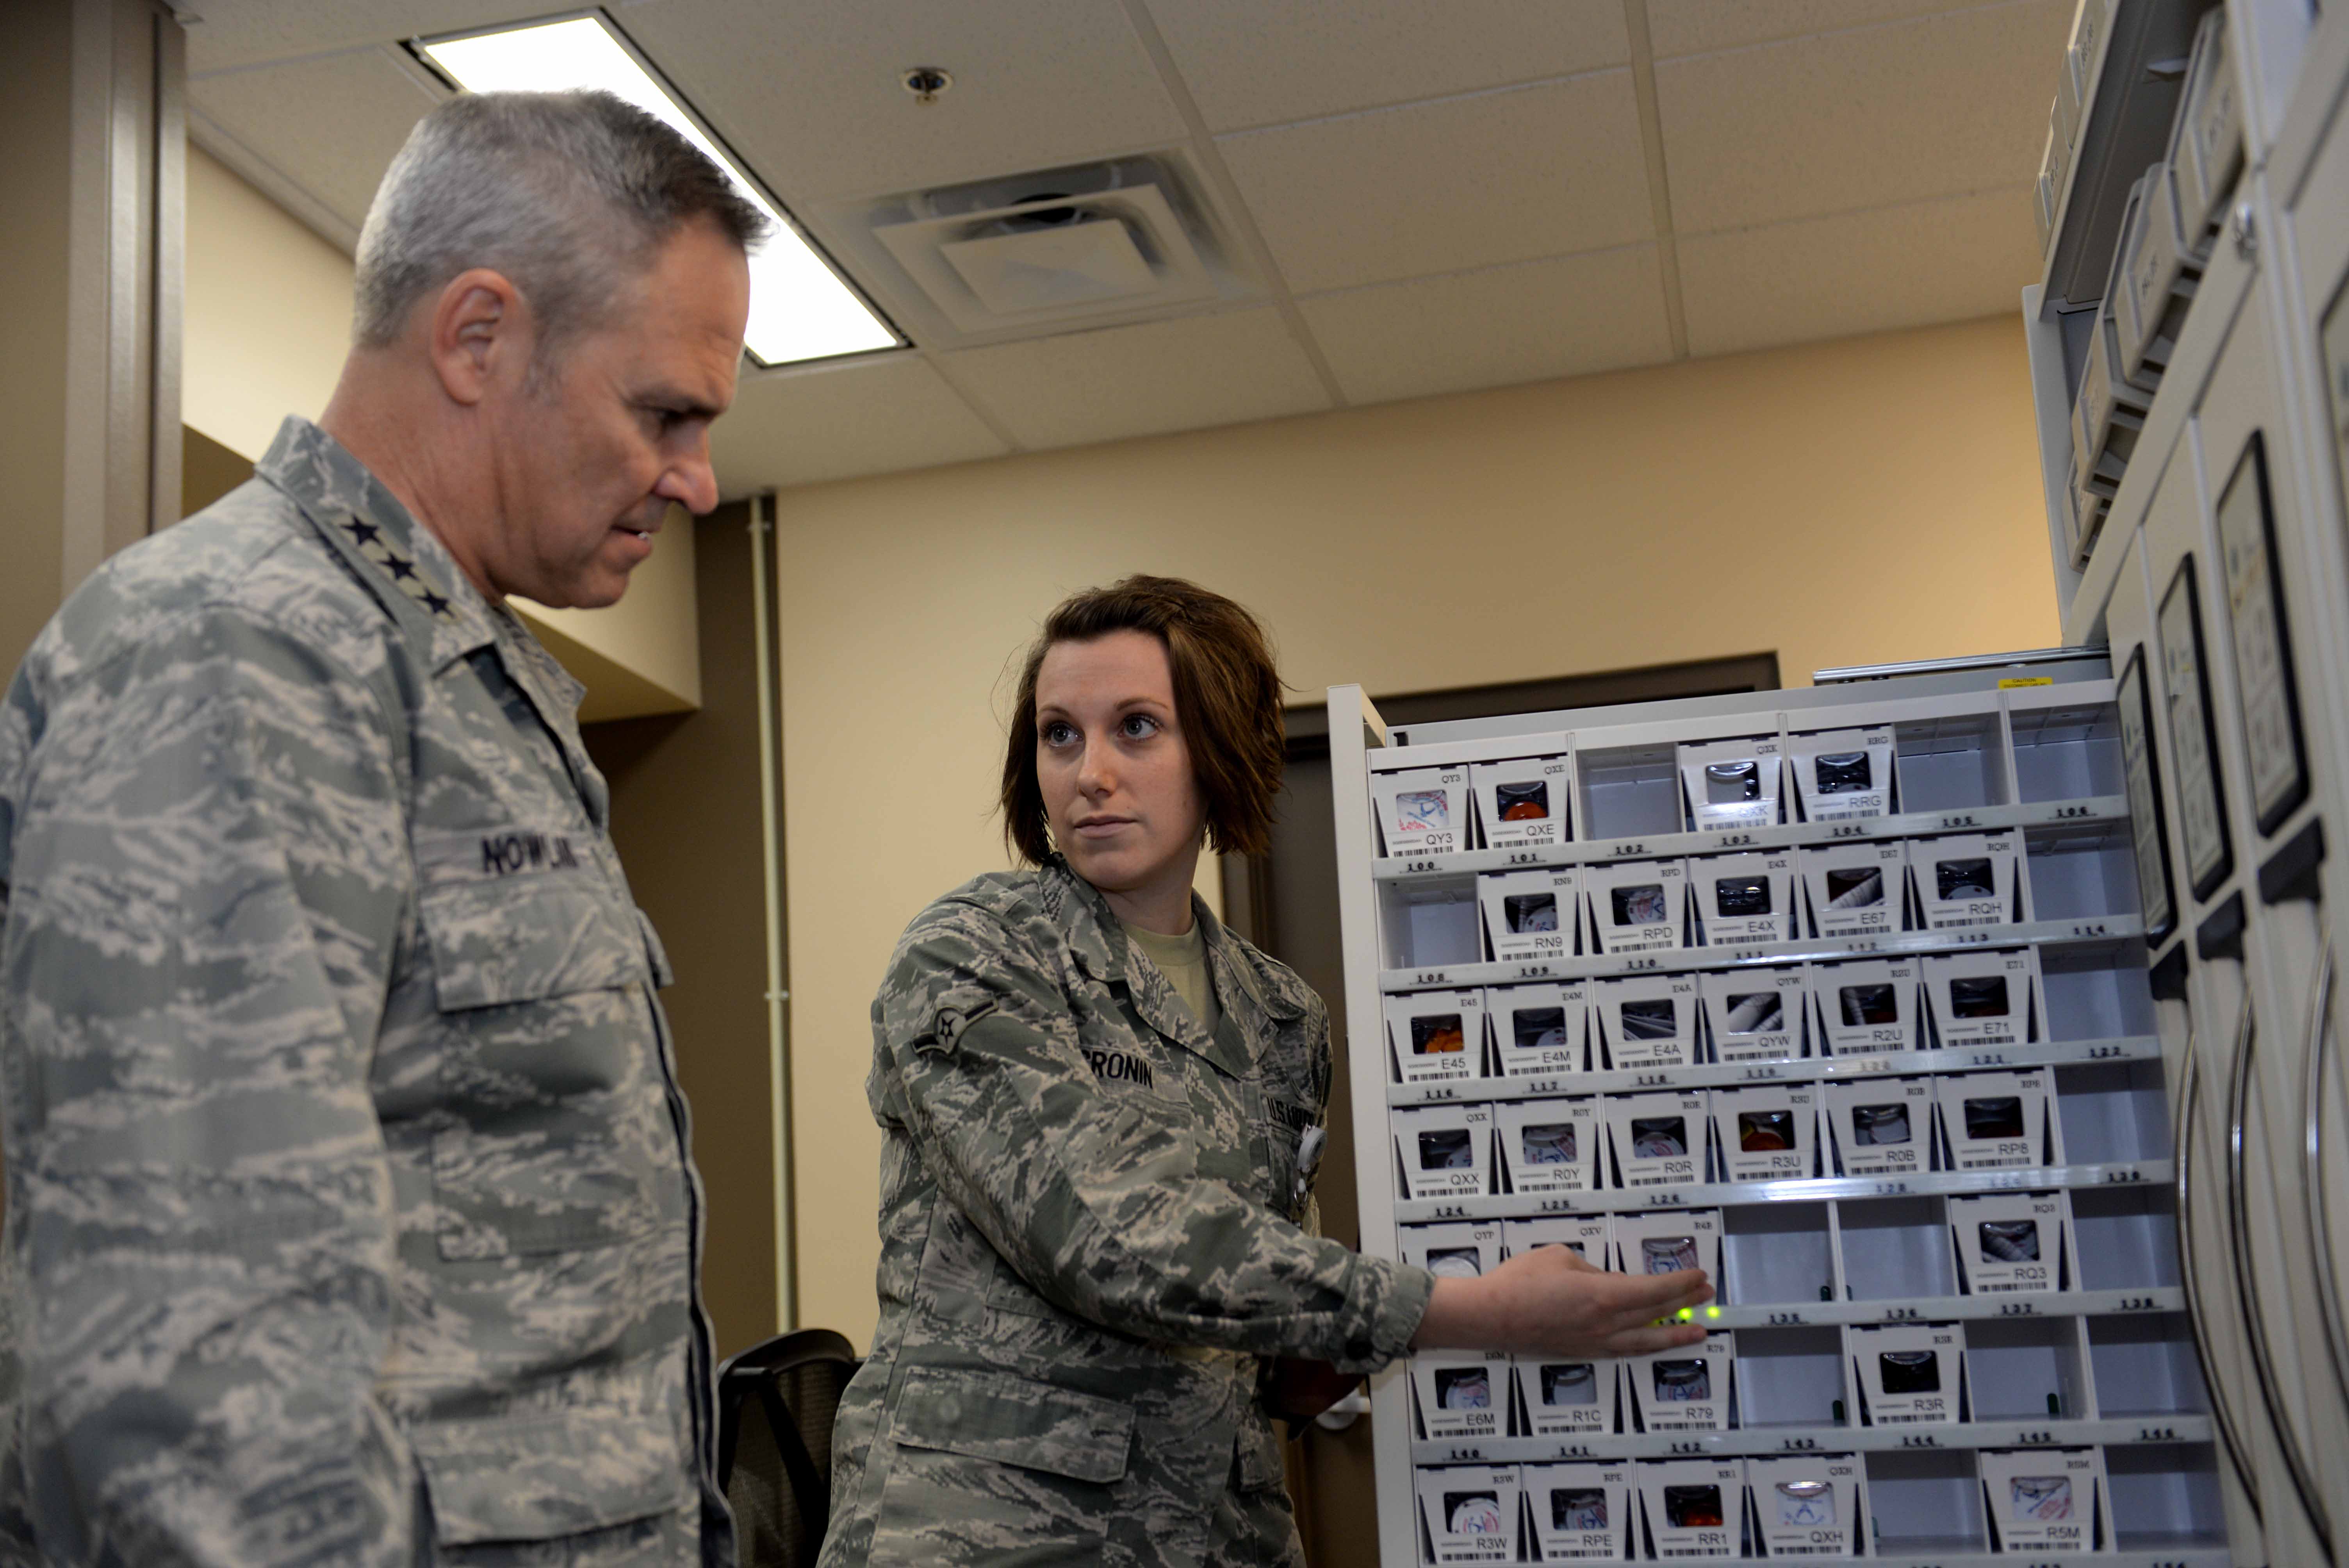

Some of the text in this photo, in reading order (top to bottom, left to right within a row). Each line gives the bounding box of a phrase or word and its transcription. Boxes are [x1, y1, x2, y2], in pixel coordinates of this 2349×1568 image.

[1544, 764, 1565, 775] QXE
[1442, 774, 1461, 784] QY3
[1850, 795, 1882, 807] RRG
[1527, 824, 1554, 836] QXE
[1426, 832, 1453, 845] QY3
[1768, 860, 1787, 869] E4X
[1661, 868, 1681, 877] RPD
[1553, 877, 1572, 886] RN9
[1969, 902, 2002, 914] RQH
[1861, 912, 1886, 925] E67
[1643, 927, 1673, 939] RPD
[1748, 921, 1775, 933] E4X
[1535, 937, 1563, 948] RN9
[1891, 969, 1910, 978] R2U
[1777, 977, 1800, 987] QYW
[1672, 984, 1692, 993] E4A
[1461, 998, 1477, 1007] E45
[1562, 992, 1583, 1001] E4M
[1984, 1022, 2009, 1034] E71
[1759, 1036, 1790, 1047] QYW
[1873, 1030, 1902, 1041] R2U
[1654, 1044, 1681, 1057] E4A
[1442, 1057, 1466, 1069] E45
[1543, 1051, 1570, 1063] E4M
[1467, 1113, 1487, 1123] QXX
[1999, 1143, 2028, 1155] RP8
[1772, 1156, 1801, 1168] R3U
[1451, 1174, 1479, 1185] QXX
[1474, 1231, 1494, 1241] QYP
[1581, 1227, 1601, 1237] QXV
[2014, 1267, 2047, 1279] RQ3
[1914, 1398, 1944, 1411] R3R
[1467, 1413, 1495, 1425] E6M
[1573, 1410, 1601, 1422] R1C
[1686, 1407, 1713, 1419] R79
[1493, 1475, 1514, 1484] R3W
[1698, 1533, 1727, 1545] RR1
[1811, 1531, 1843, 1543] QXH
[2047, 1527, 2080, 1539] R5M
[1477, 1538, 1507, 1549] R3W
[1583, 1534, 1611, 1547] RPE
